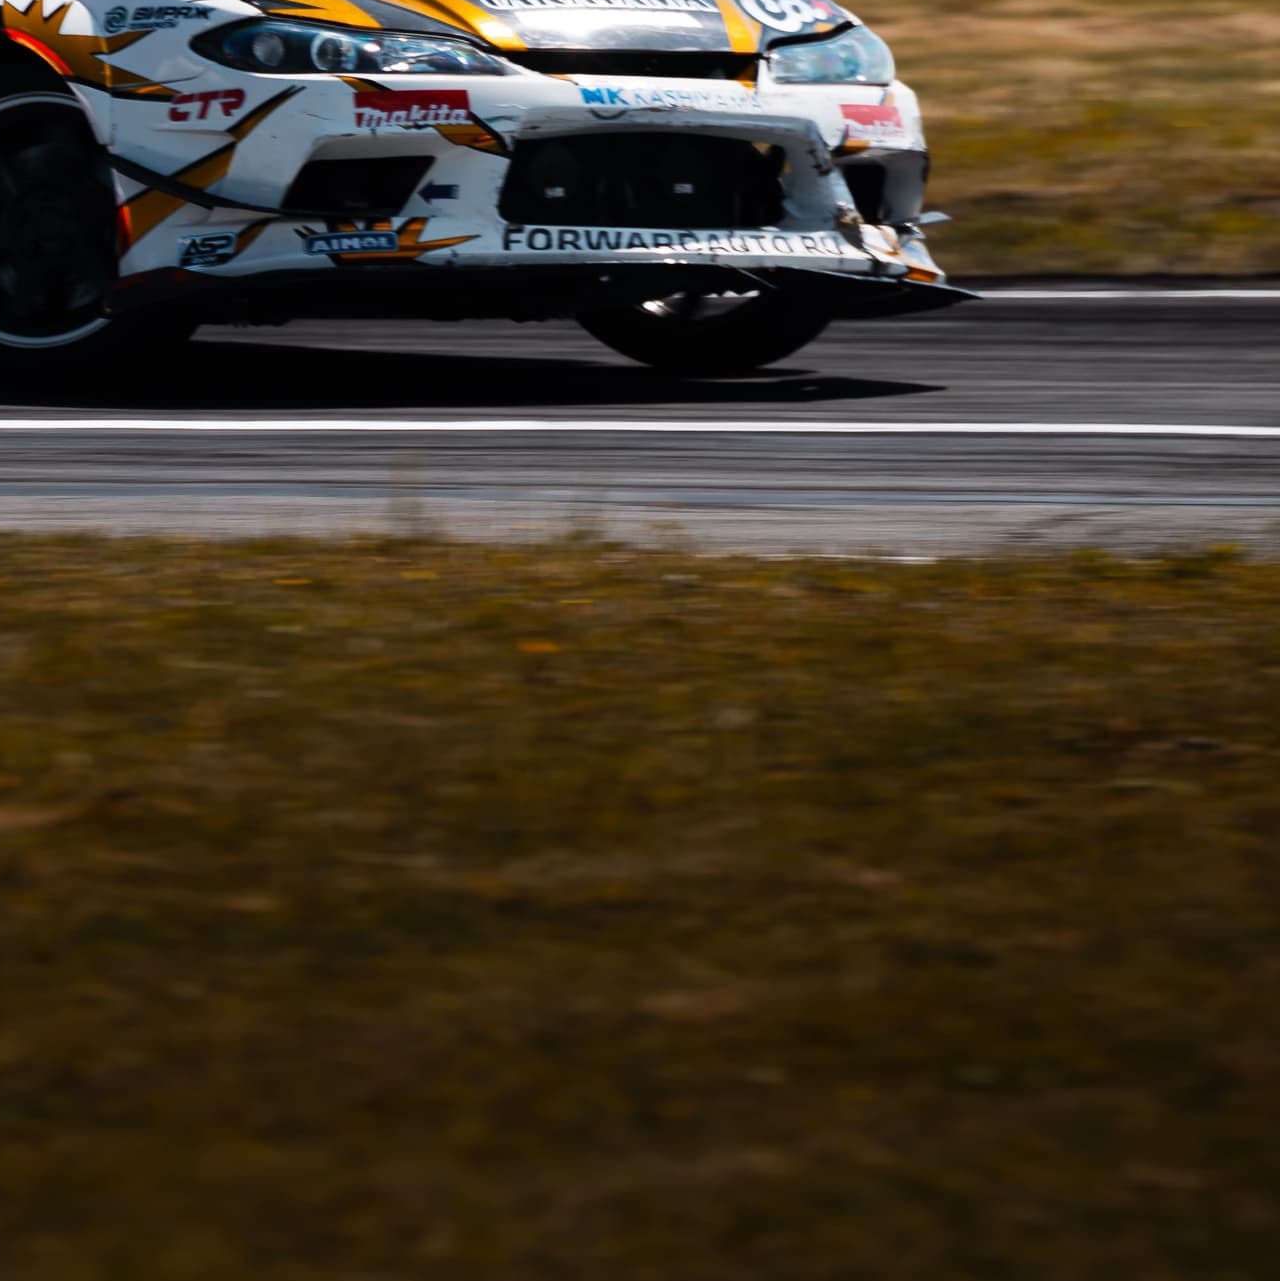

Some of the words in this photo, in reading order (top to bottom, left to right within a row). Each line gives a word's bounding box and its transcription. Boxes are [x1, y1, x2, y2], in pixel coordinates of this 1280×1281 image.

[168, 89, 245, 122] CTR
[578, 87, 630, 106] NK
[355, 104, 471, 128] makita
